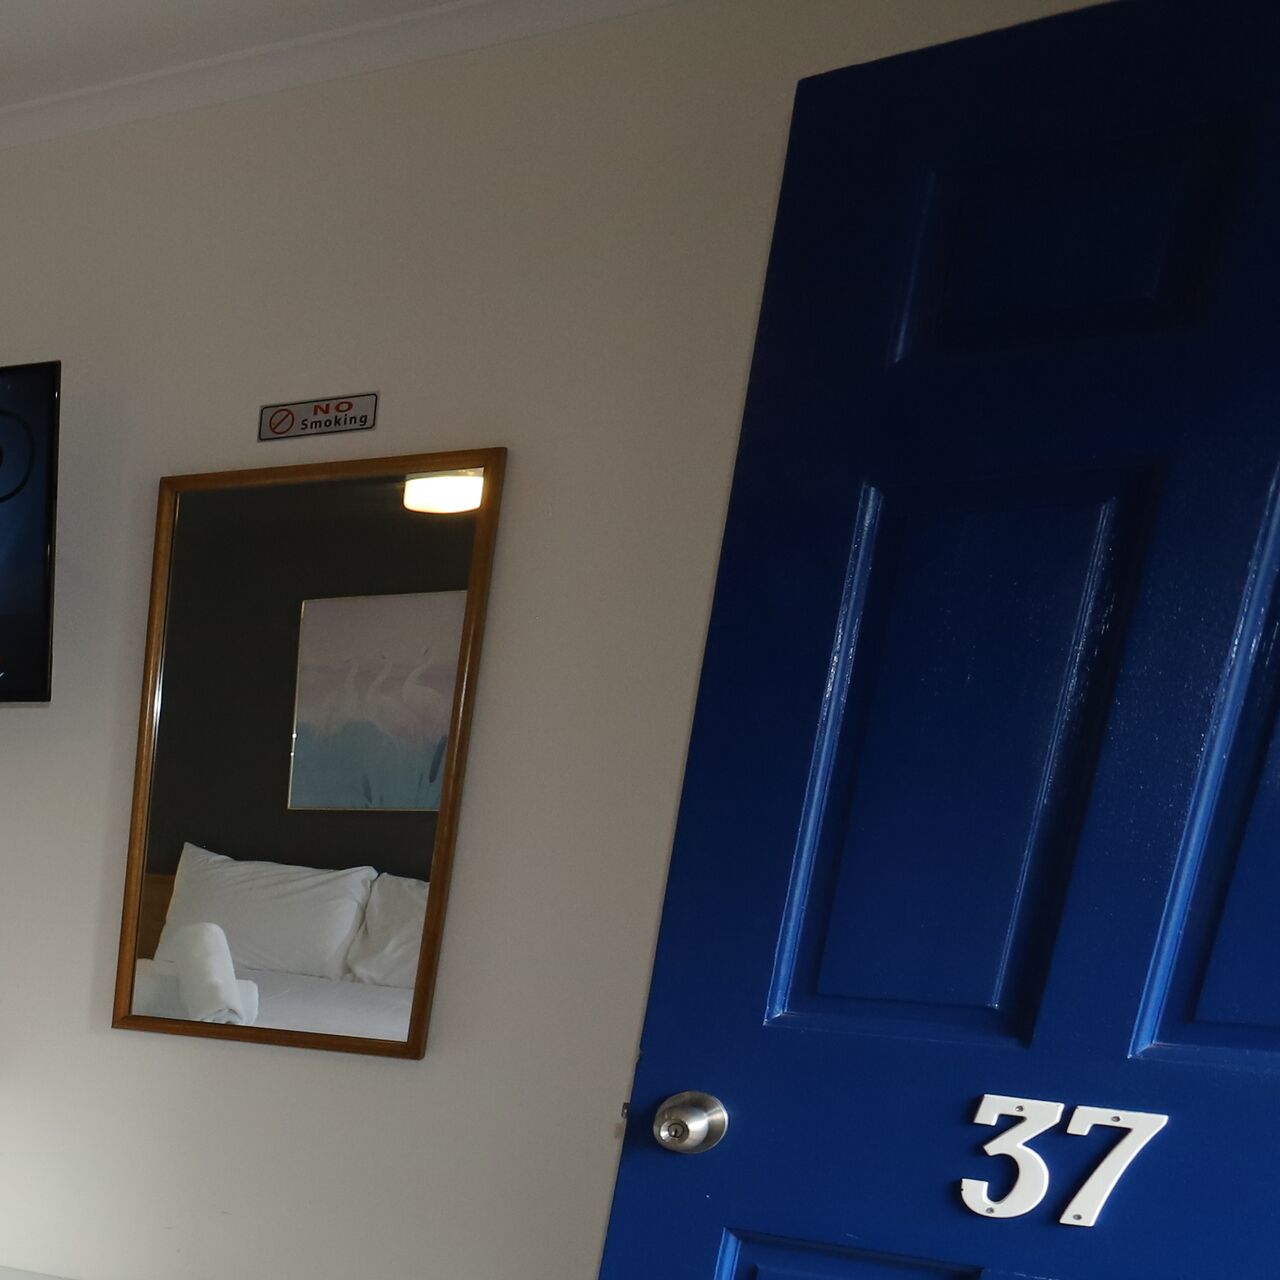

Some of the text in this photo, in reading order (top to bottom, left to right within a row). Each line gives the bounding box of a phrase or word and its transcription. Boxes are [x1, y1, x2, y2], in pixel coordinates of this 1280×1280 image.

[312, 401, 354, 416] NO
[300, 414, 368, 431] Smoking
[960, 1093, 1169, 1227] 37
